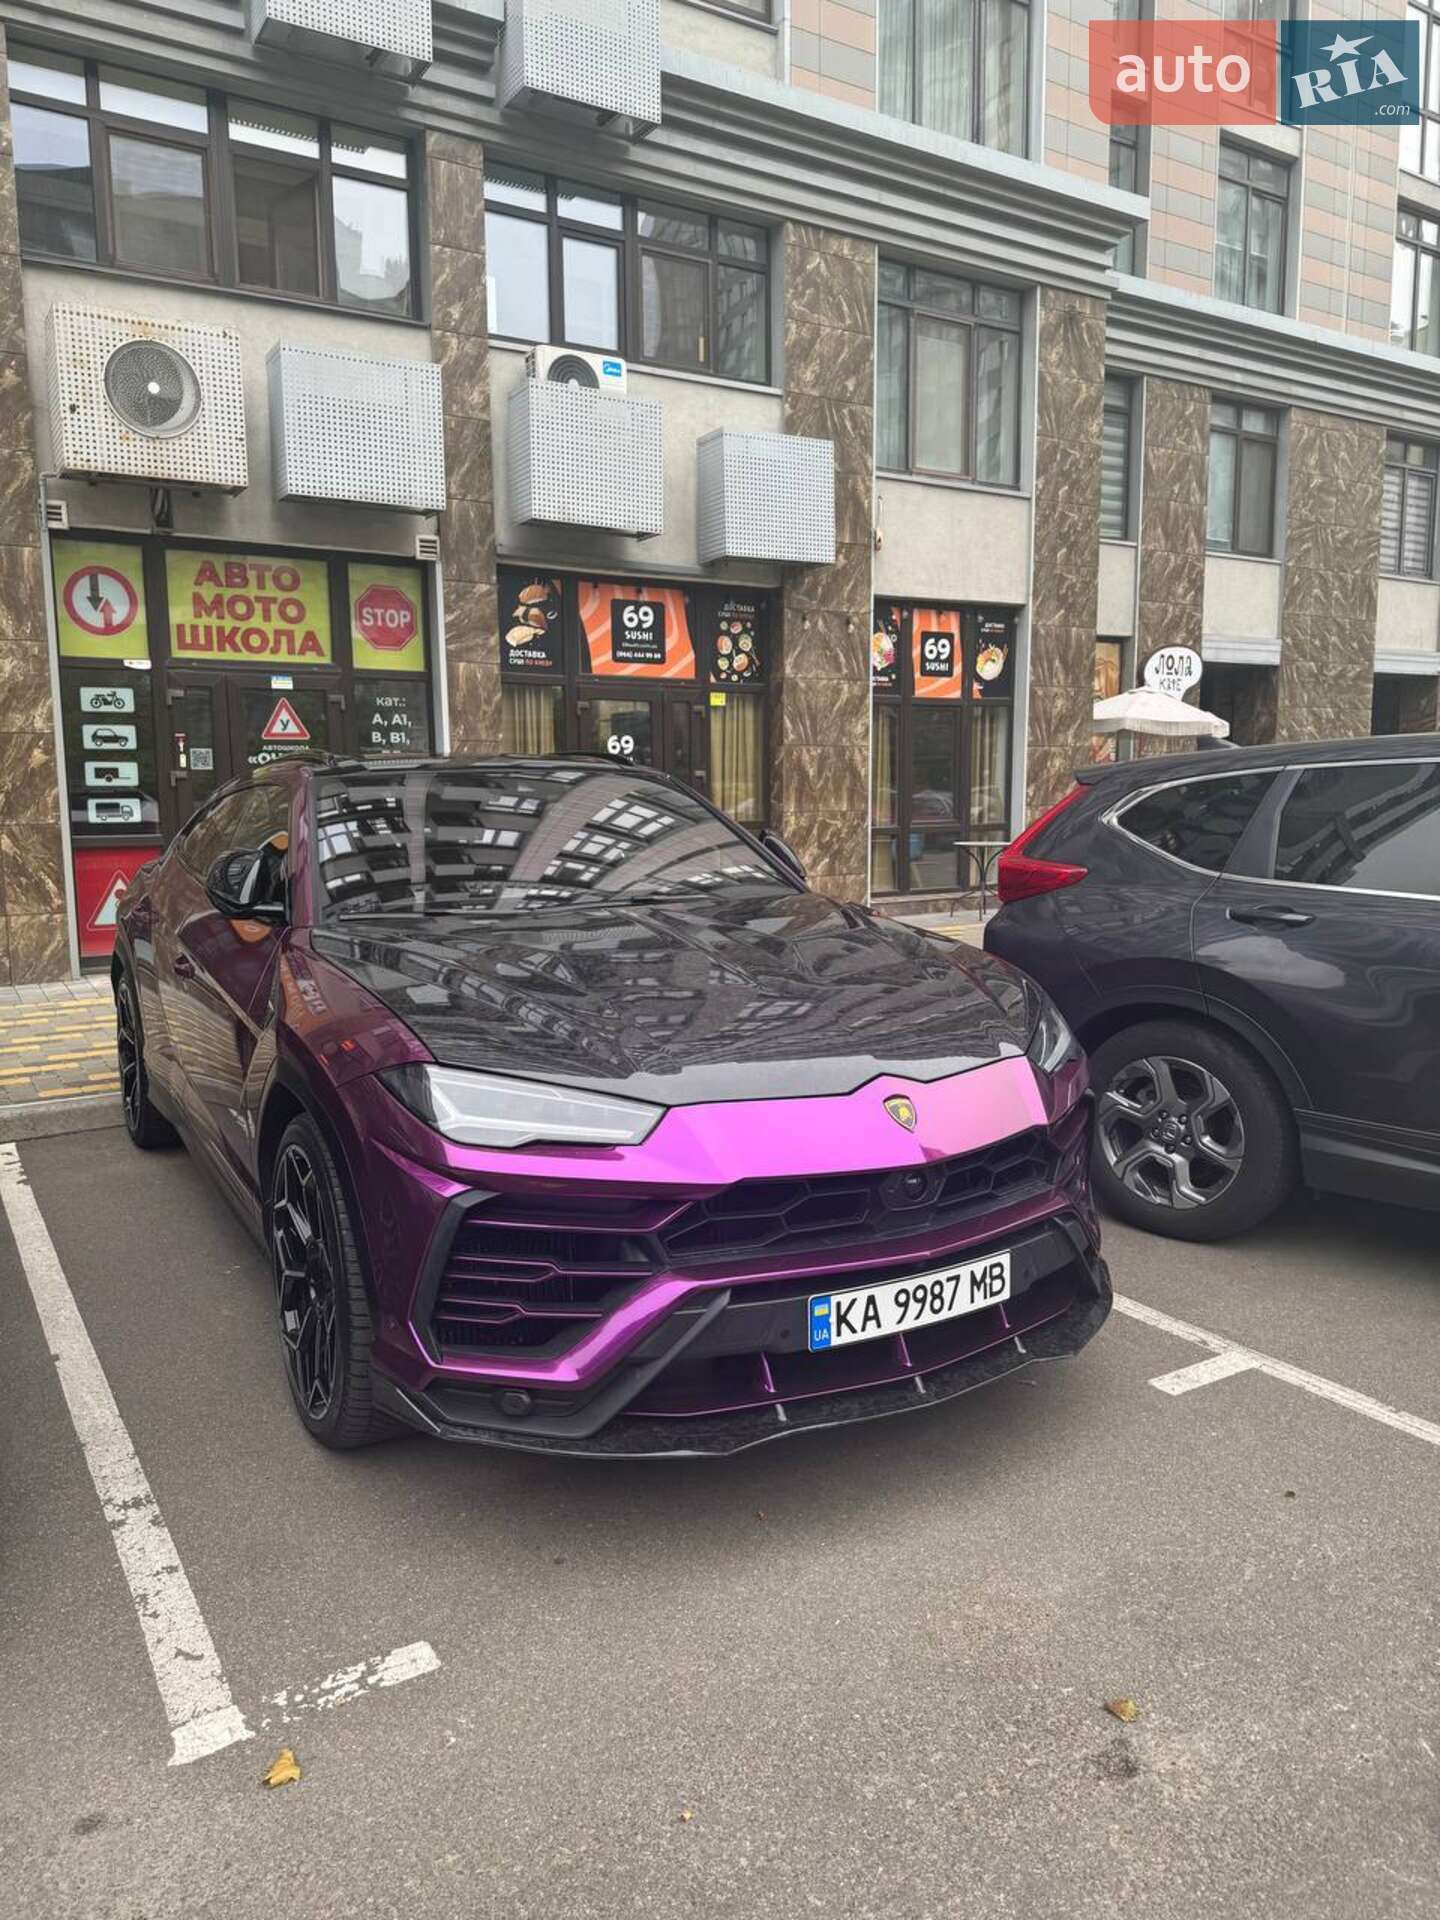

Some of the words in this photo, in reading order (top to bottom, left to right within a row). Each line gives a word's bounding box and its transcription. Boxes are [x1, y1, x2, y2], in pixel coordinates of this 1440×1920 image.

[193, 559, 301, 592] АВТО
[191, 591, 306, 625] МОТО
[362, 607, 411, 628] STOP
[623, 605, 655, 629] 69
[176, 623, 326, 657] ШКОЛА
[624, 630, 654, 641] SUSHI
[509, 649, 547, 659] ДОСТАВКА
[924, 638, 951, 660] 69
[924, 661, 950, 672] SUSHI
[607, 735, 634, 755] 69
[835, 1294, 881, 1337] KA
[894, 1274, 961, 1325] 9987
[970, 1262, 1006, 1304] MB
[814, 1330, 829, 1341] UA
